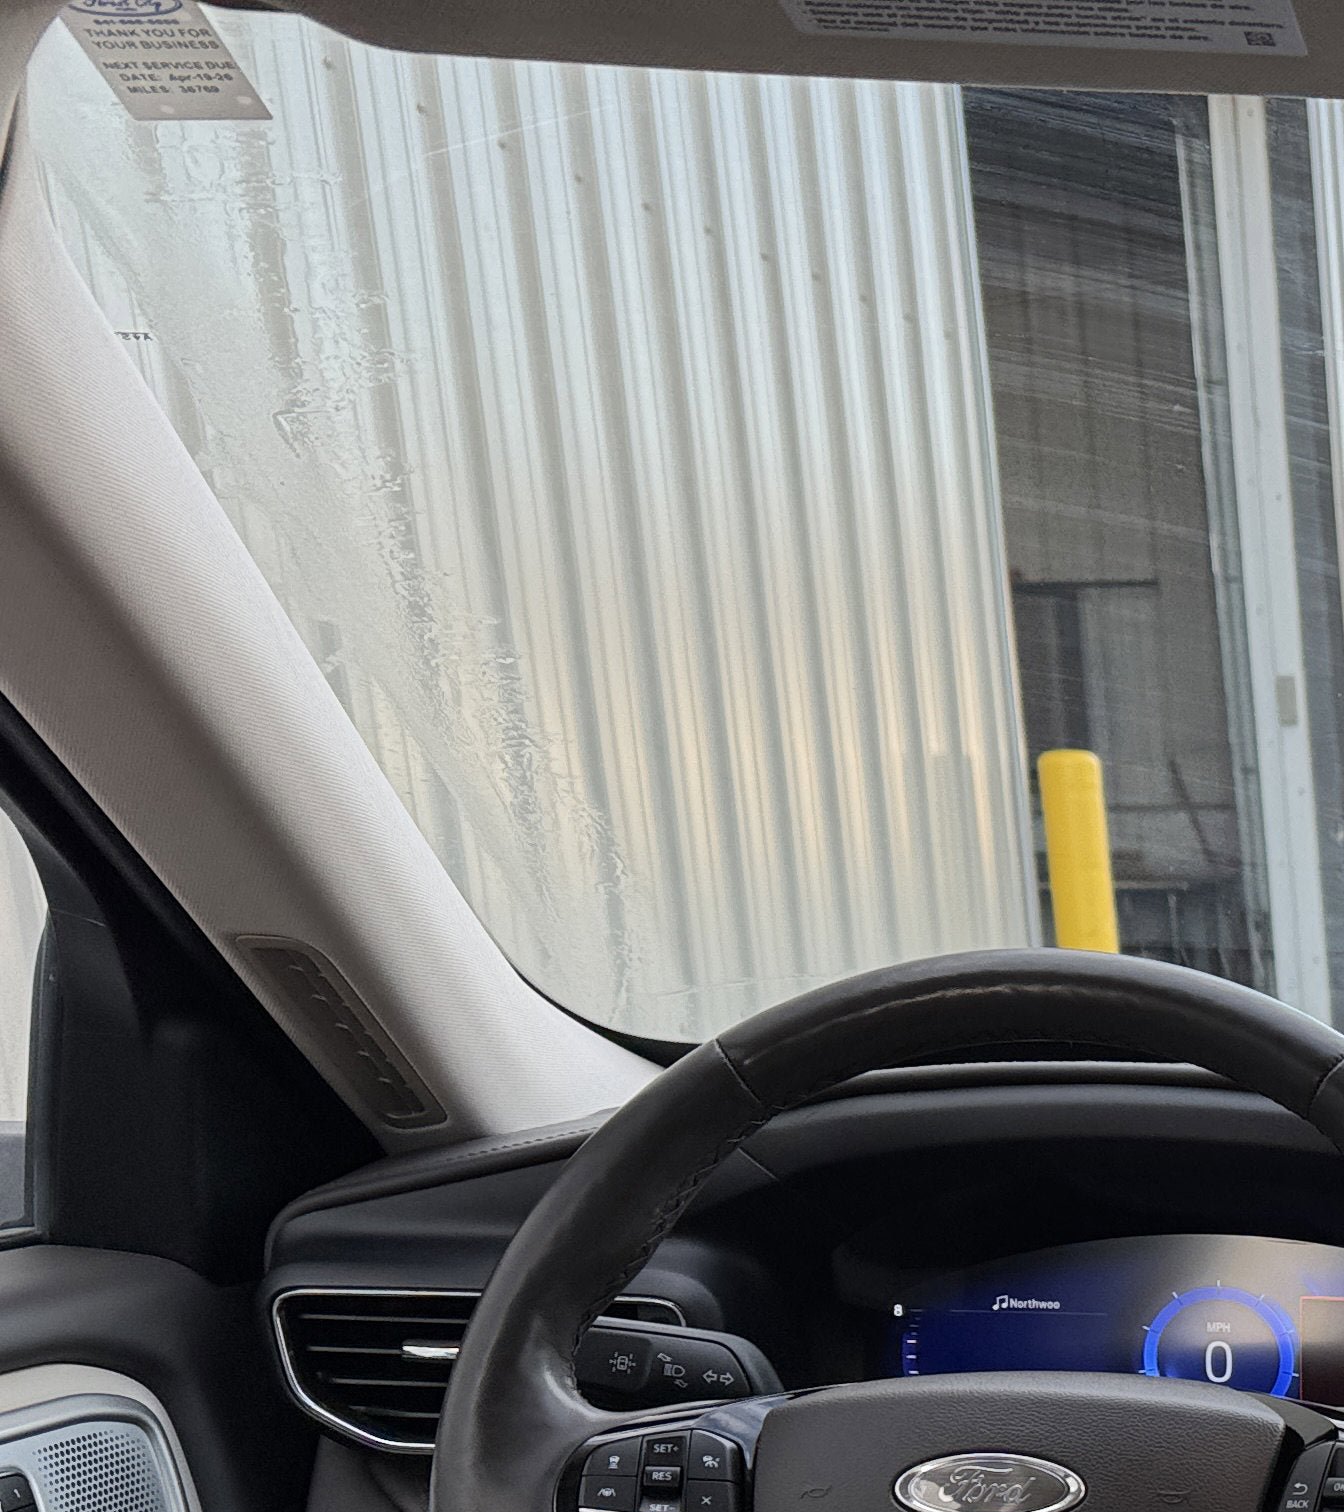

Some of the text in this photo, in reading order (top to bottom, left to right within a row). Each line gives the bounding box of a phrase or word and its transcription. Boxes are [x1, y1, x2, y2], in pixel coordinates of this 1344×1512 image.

[83, 28, 212, 38] THANK YOU FOR
[91, 40, 220, 50] YOUR BUSINESS
[102, 61, 140, 70] NEXT
[143, 61, 203, 70] SERVICE
[1009, 1298, 1061, 1311] Northwoo
[1206, 1322, 1232, 1334] MPH
[1204, 1341, 1233, 1384] 0
[651, 1471, 673, 1481] RES
[937, 1465, 1036, 1504] Ford
[1285, 1499, 1310, 1509] BACK
